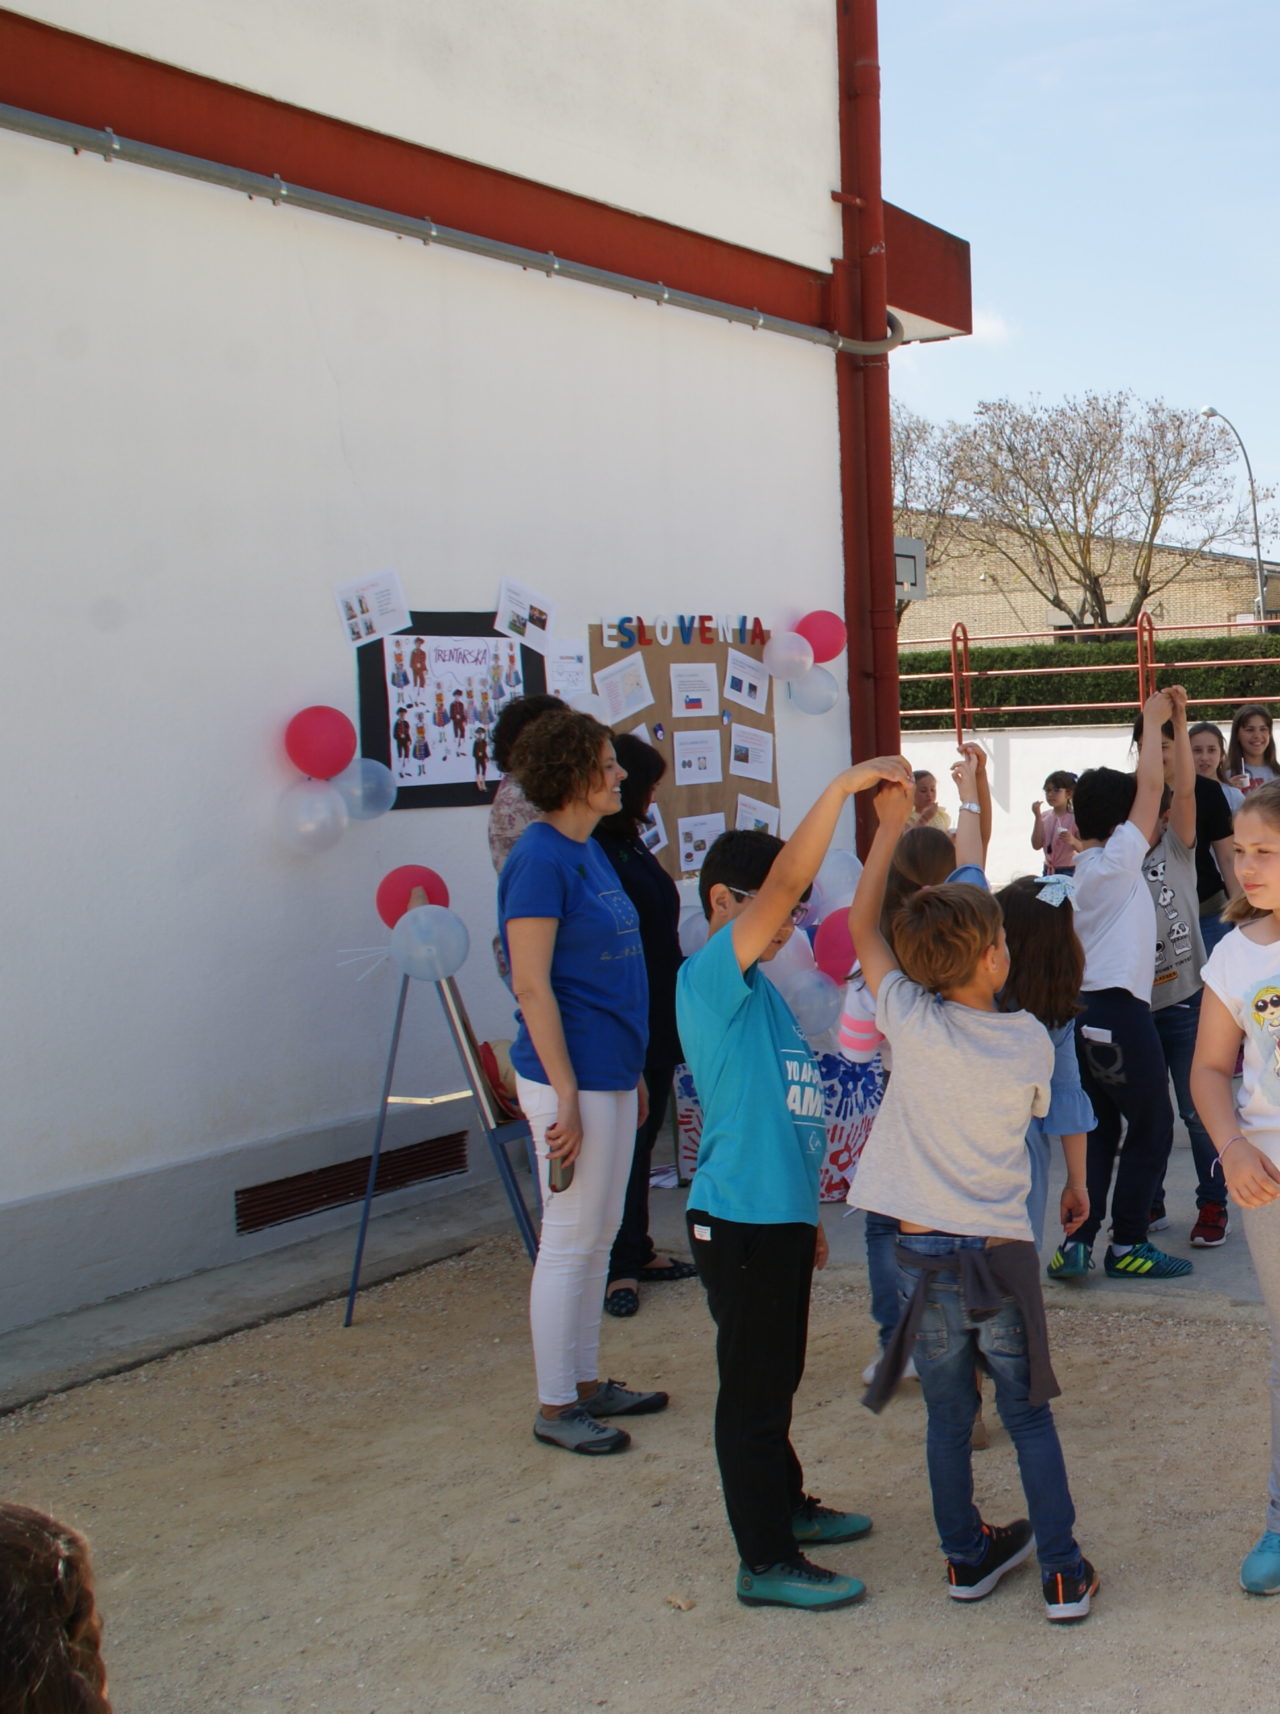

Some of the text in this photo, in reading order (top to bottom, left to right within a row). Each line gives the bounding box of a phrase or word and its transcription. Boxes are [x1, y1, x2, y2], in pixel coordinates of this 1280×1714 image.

[602, 614, 766, 648] ESLOVENIA
[434, 647, 488, 666] TRENTARSKA
[786, 1084, 824, 1119] AM
